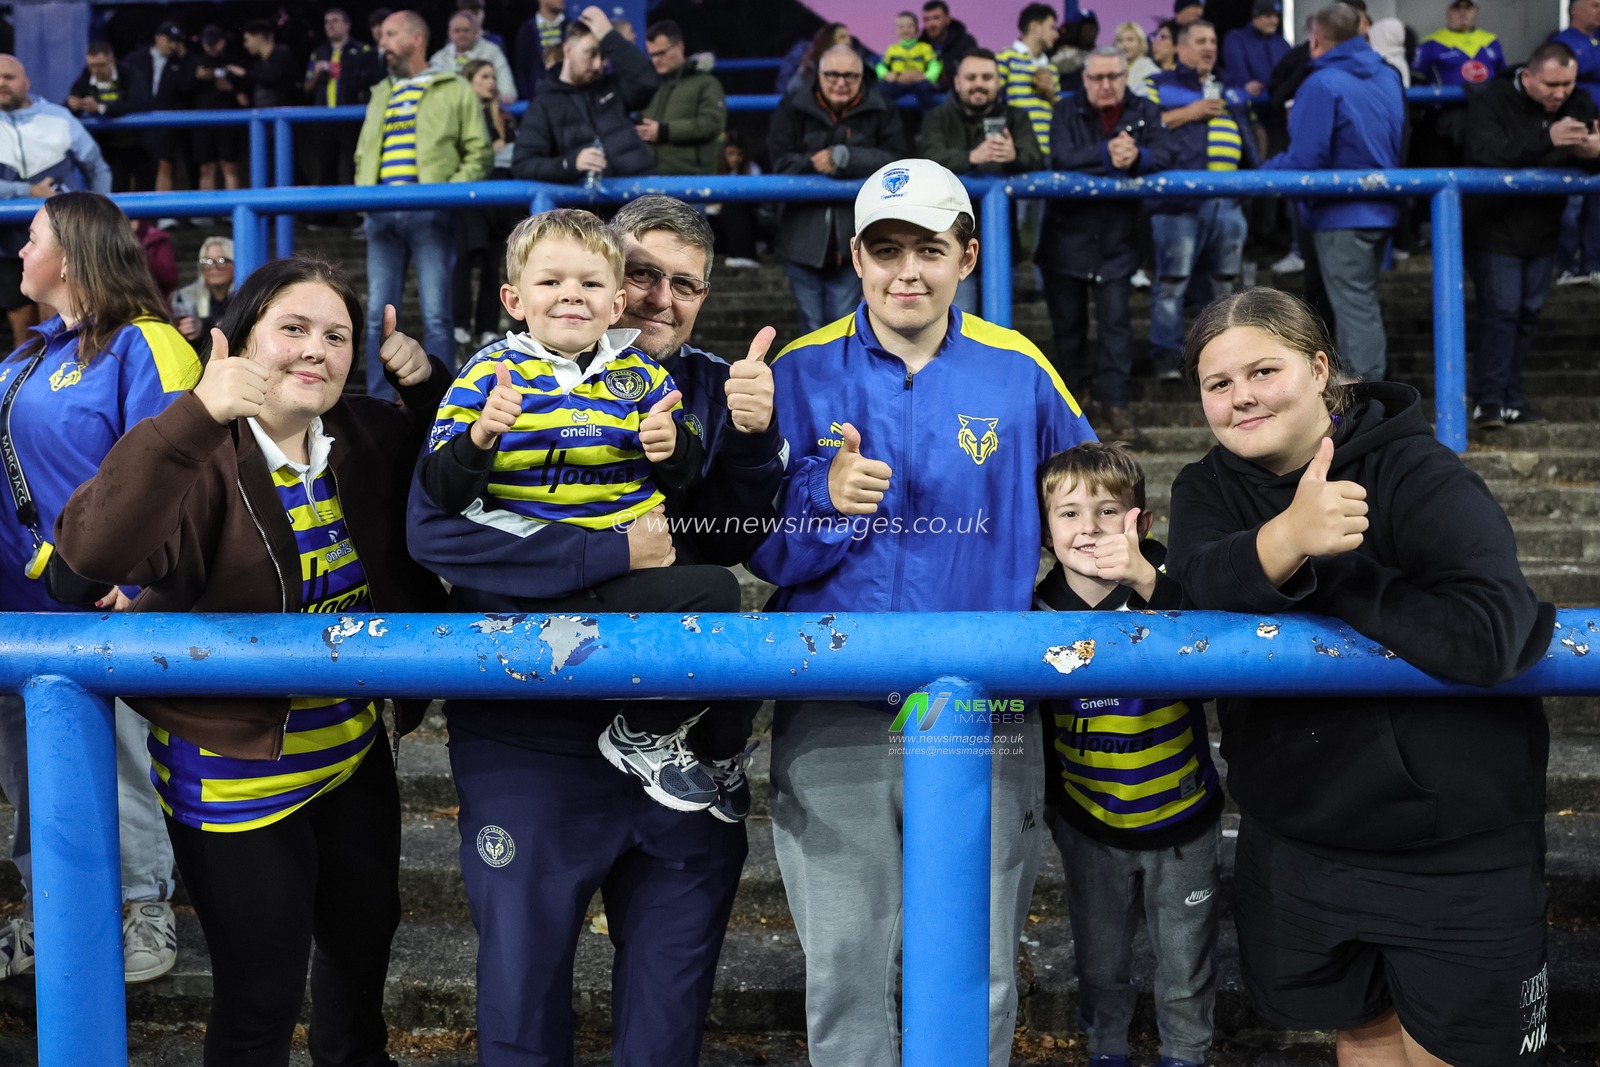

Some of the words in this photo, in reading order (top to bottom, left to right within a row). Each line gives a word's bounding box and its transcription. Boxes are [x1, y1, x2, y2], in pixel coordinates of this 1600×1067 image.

[1, 434, 17, 473] MARC
[530, 440, 636, 493] HOOVER
[1189, 888, 1210, 901] NIKE
[1519, 1022, 1548, 1055] NIK
